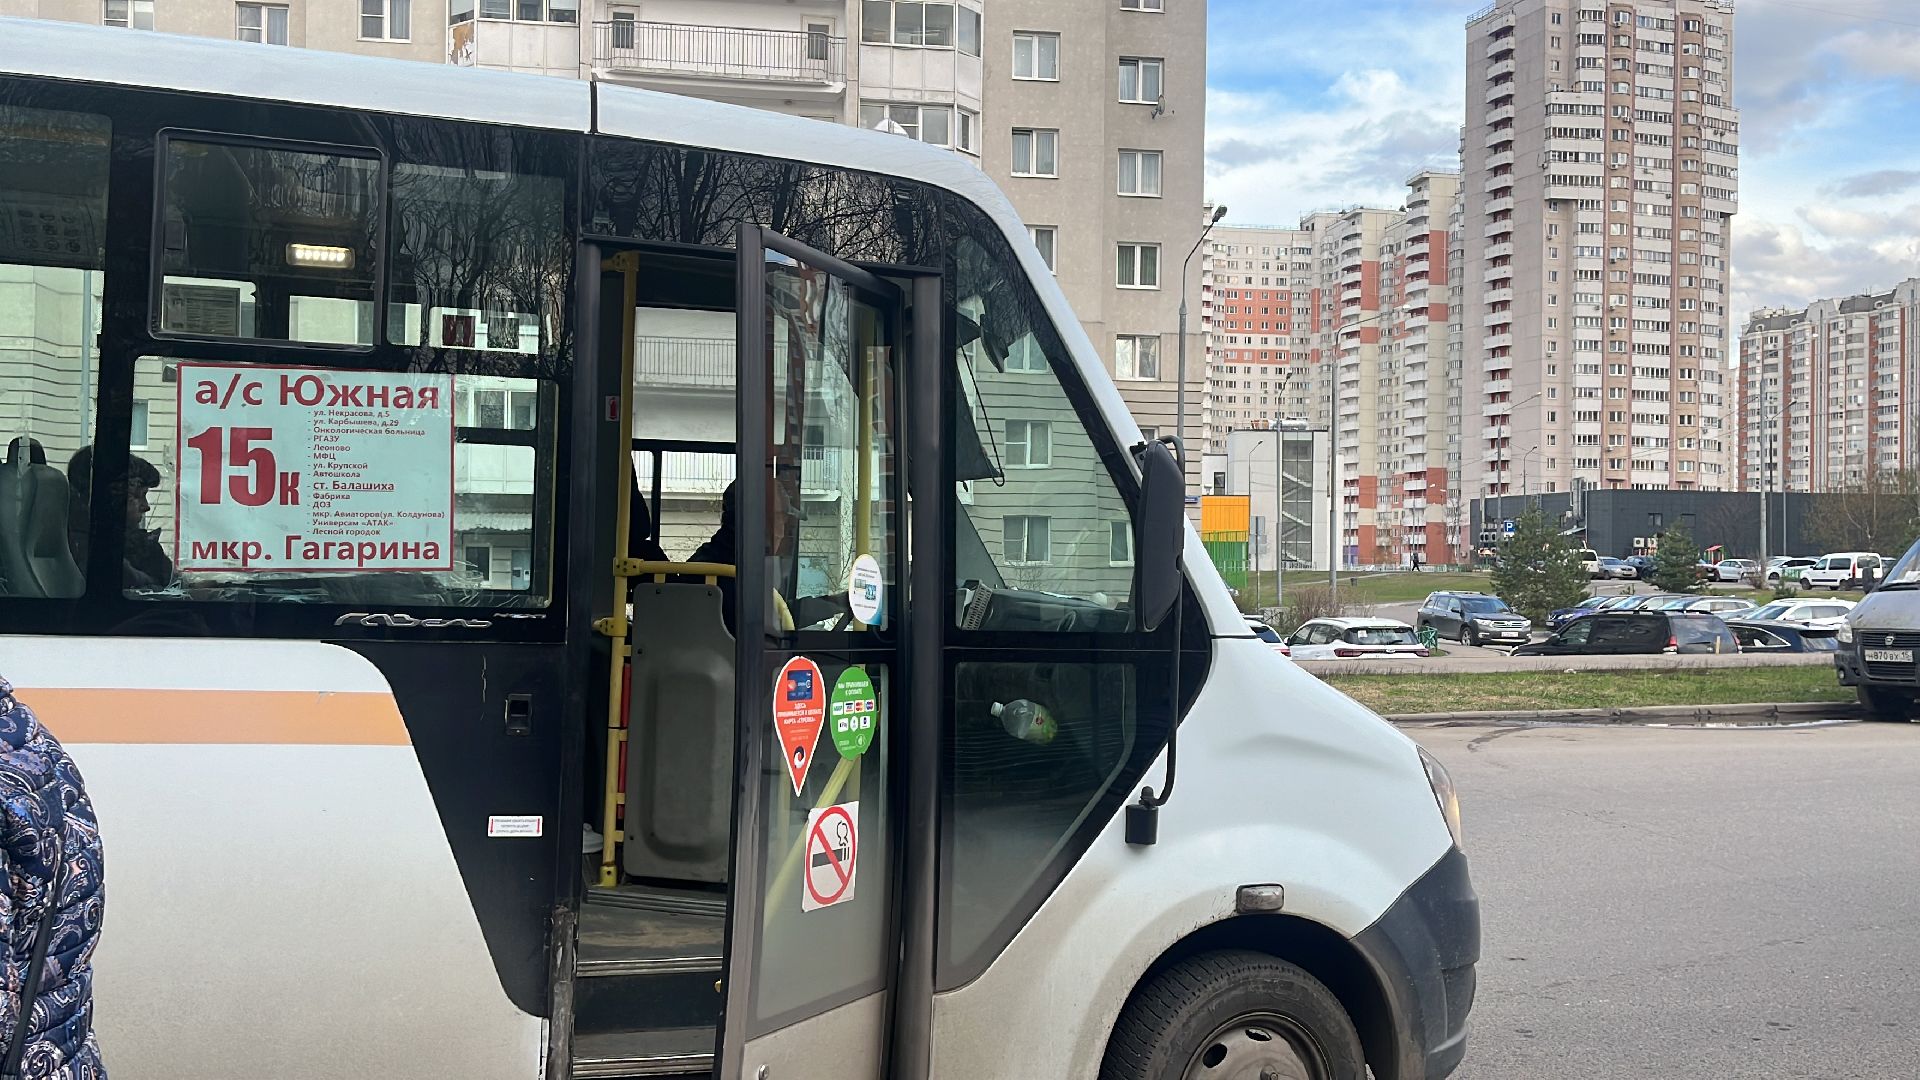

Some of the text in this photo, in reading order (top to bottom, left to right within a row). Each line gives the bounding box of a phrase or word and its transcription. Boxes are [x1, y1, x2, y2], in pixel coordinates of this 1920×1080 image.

[195, 373, 439, 410] а/с Южная
[328, 410, 375, 418] Некрасова,
[313, 418, 326, 426] ул.
[328, 418, 379, 426] Карбышева,
[313, 426, 426, 436] Онкологическая больница
[313, 444, 351, 452] Леоново
[313, 452, 336, 460] МФЦ
[313, 462, 368, 470] ул. Крупской
[313, 480, 395, 491] ст. Балашиха
[313, 492, 351, 500] Фабрика
[313, 501, 331, 509] ДОЗ
[312, 519, 359, 527] Универсам
[312, 527, 344, 535] Лесной
[192, 535, 440, 567] мкр. Гагарина
